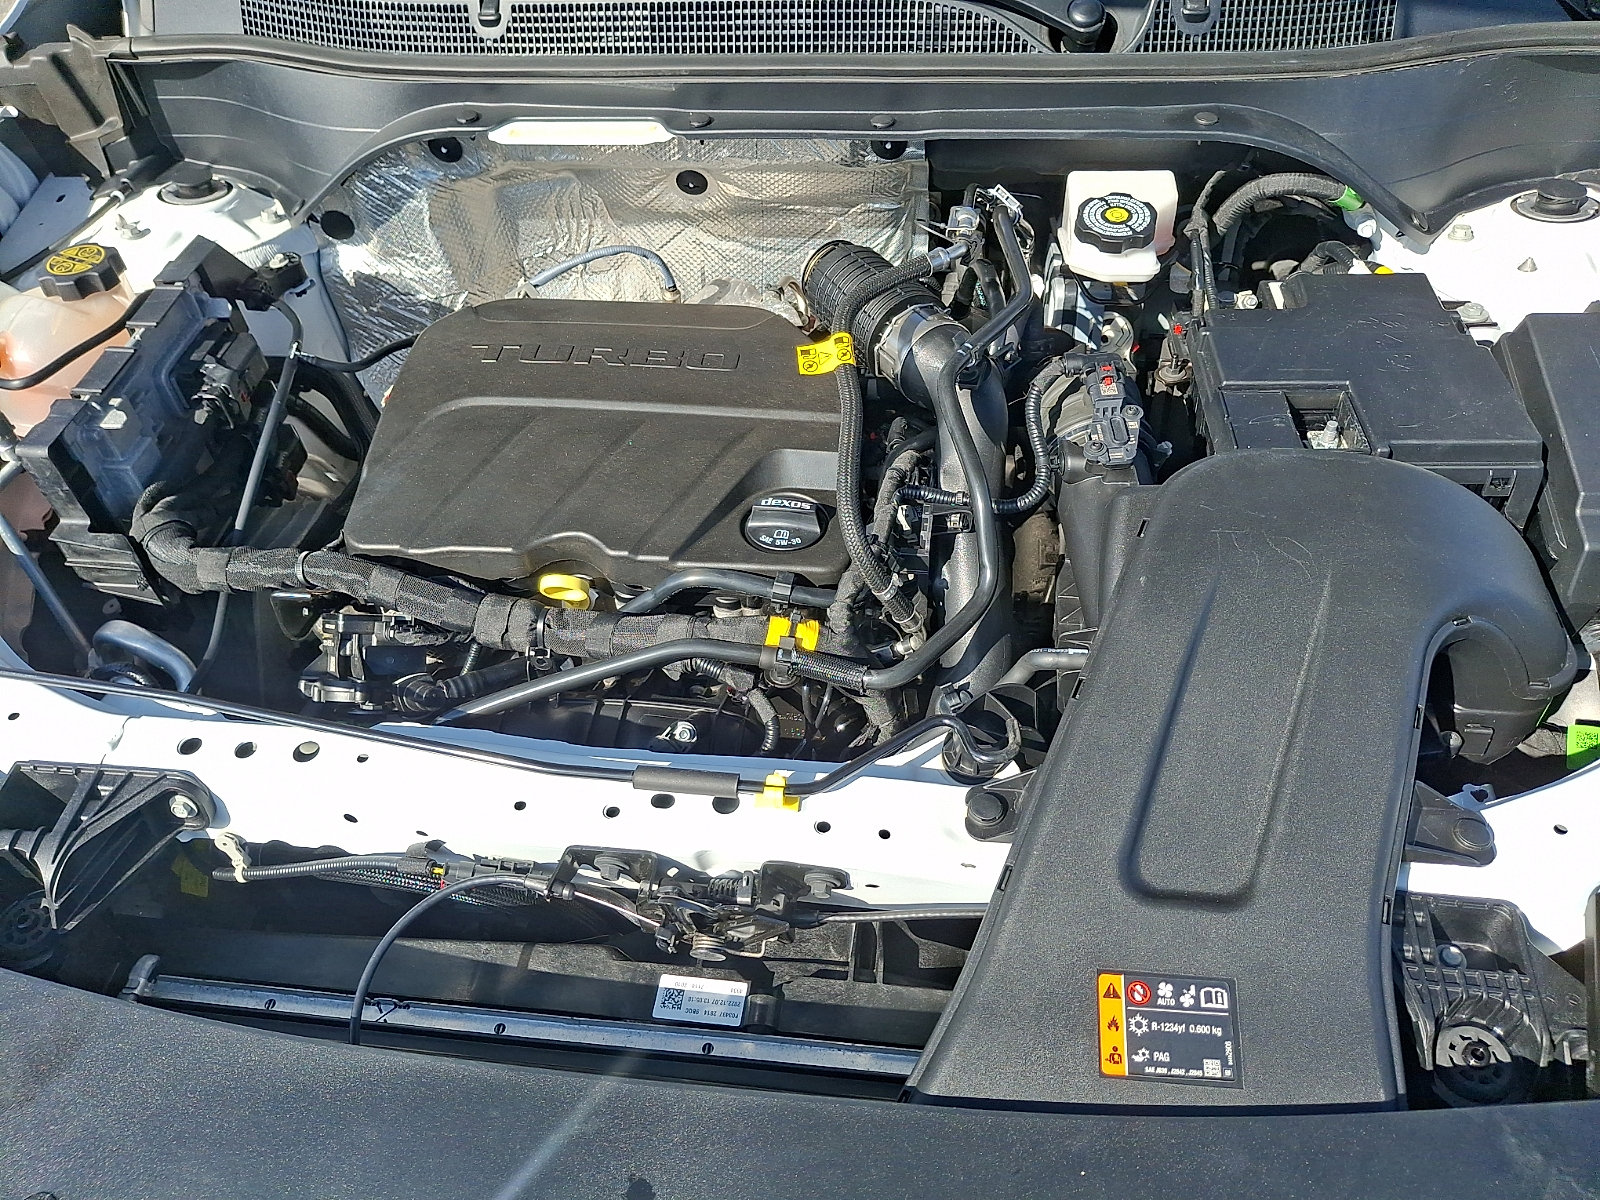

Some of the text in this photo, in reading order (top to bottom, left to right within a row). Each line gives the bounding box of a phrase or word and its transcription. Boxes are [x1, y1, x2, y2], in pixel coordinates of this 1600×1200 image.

[472, 344, 741, 371] TURBO
[761, 497, 813, 510] dexos
[759, 535, 802, 545] SAE 5W-30
[1157, 998, 1176, 1006] AUTO
[1151, 1022, 1222, 1037] R-1234yf 0.600 kg
[1153, 1051, 1170, 1062] PAG
